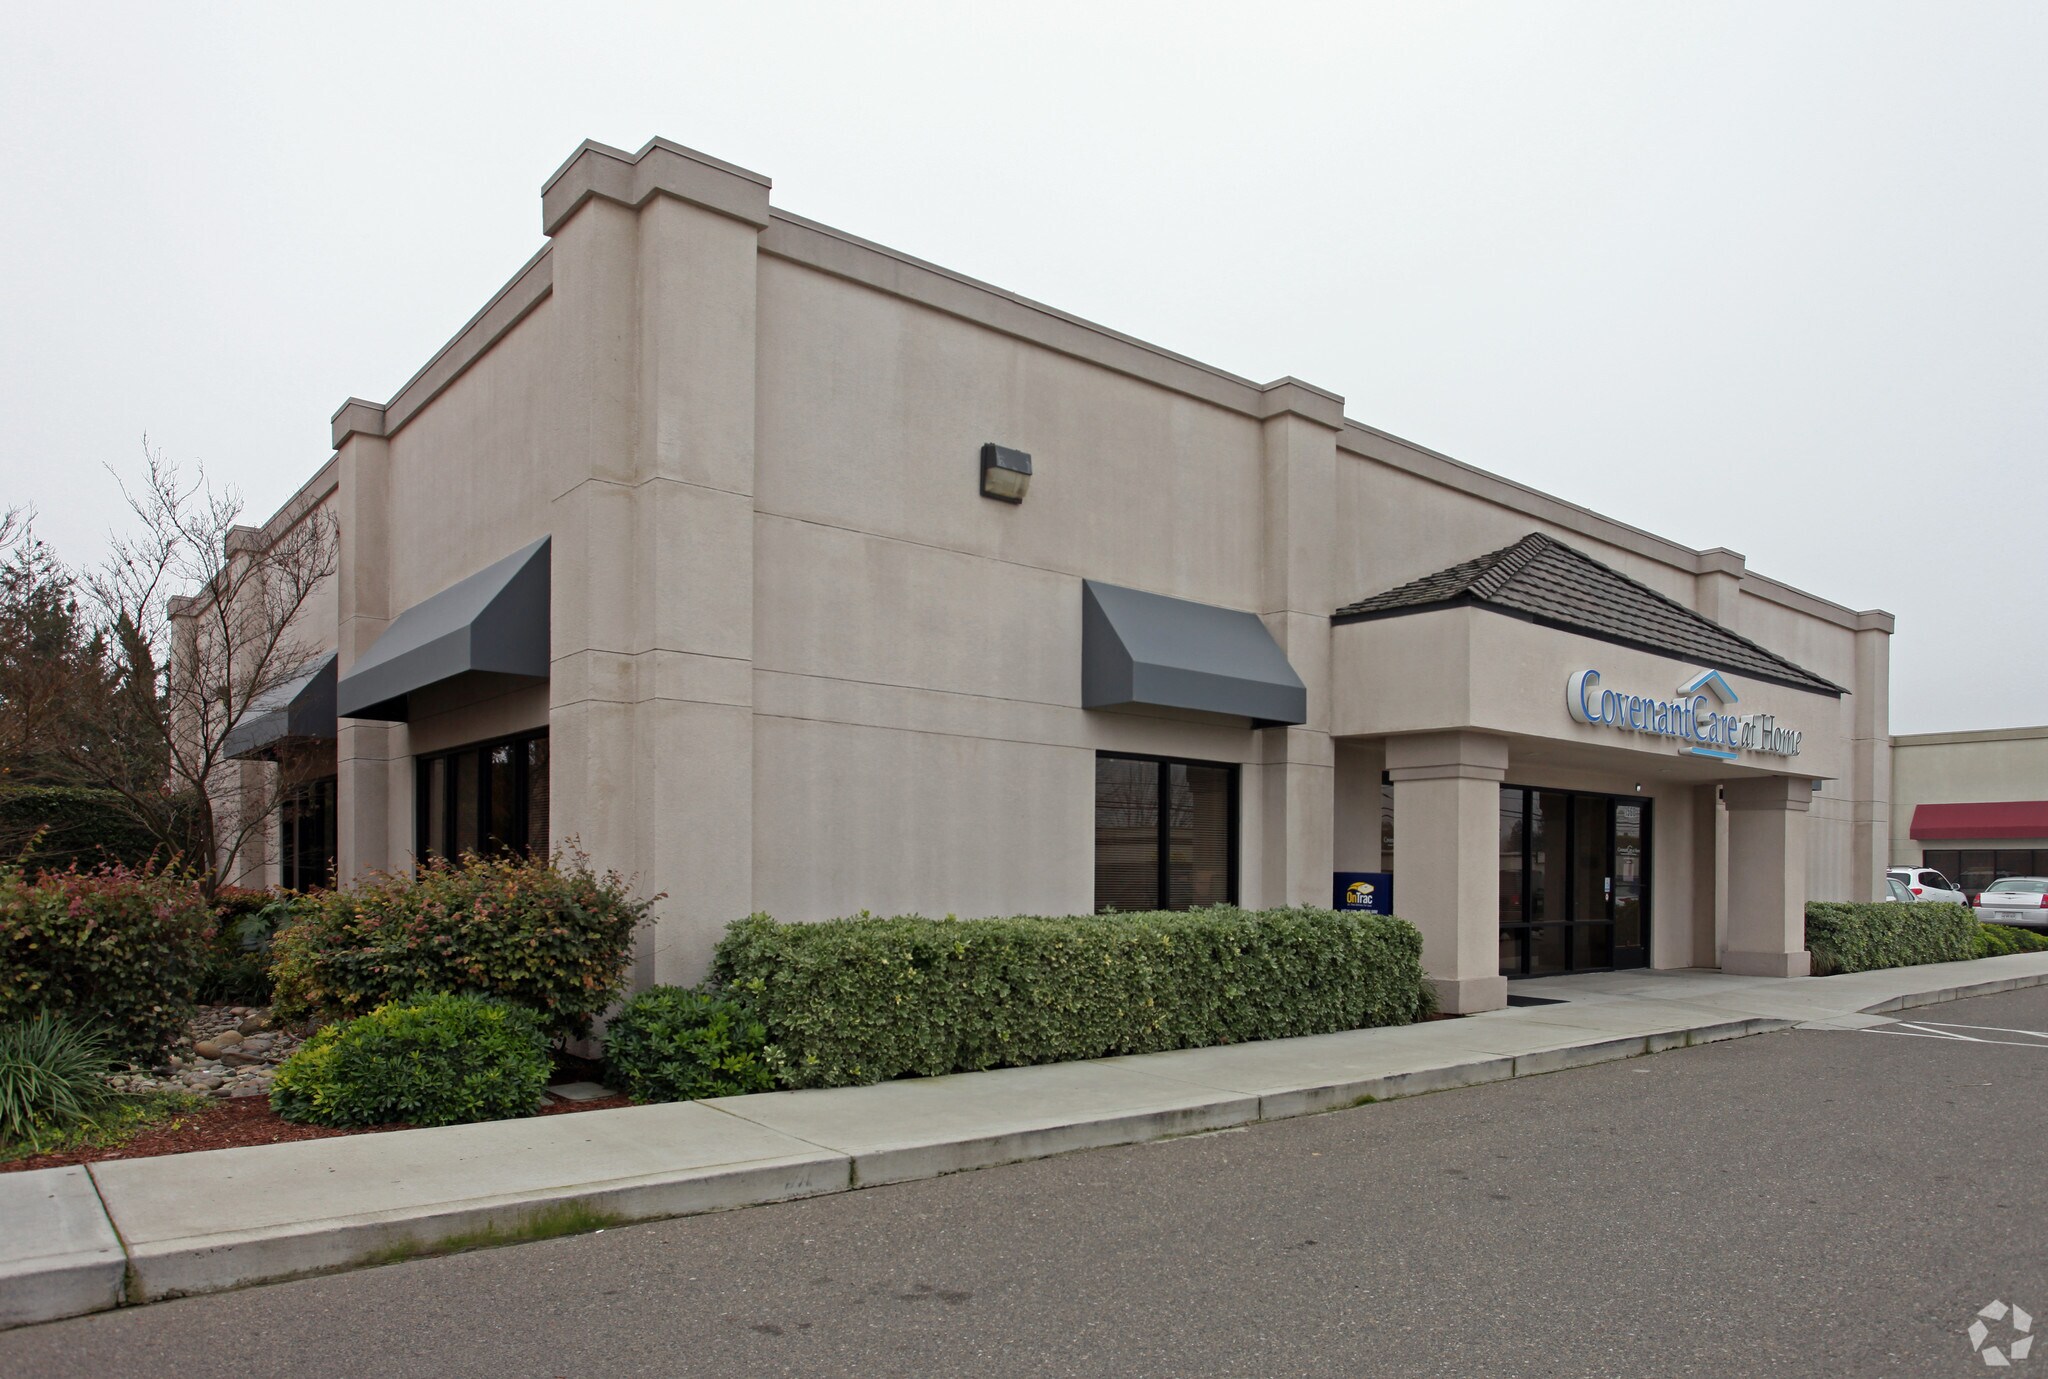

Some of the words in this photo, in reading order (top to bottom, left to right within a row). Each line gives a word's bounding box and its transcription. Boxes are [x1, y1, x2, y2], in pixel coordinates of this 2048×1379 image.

[1741, 715, 1757, 748] at
[1761, 713, 1802, 755] Home
[1346, 891, 1373, 904] OnTrac
